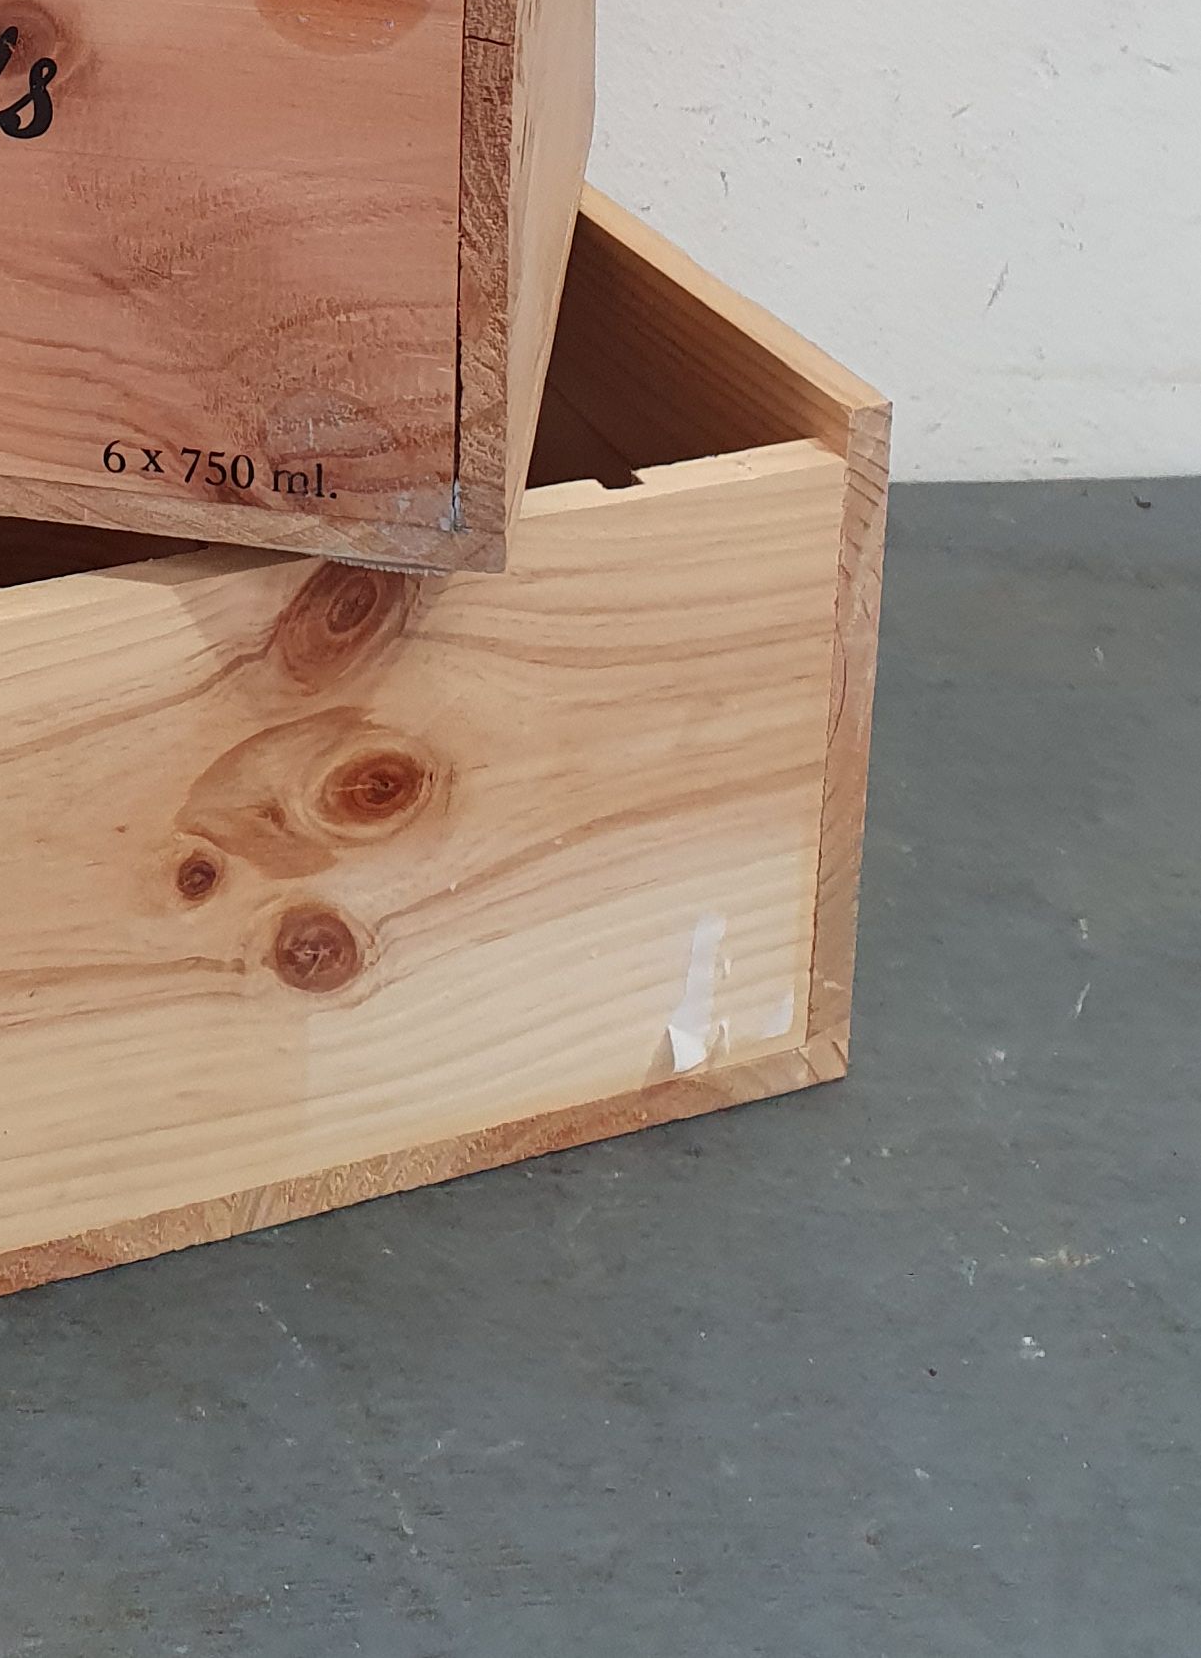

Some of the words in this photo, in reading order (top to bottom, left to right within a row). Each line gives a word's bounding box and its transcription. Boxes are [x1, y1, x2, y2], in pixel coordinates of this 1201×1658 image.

[103, 440, 126, 474] 6
[140, 448, 165, 473] x
[180, 447, 255, 489] 750
[272, 463, 338, 499] ml.
